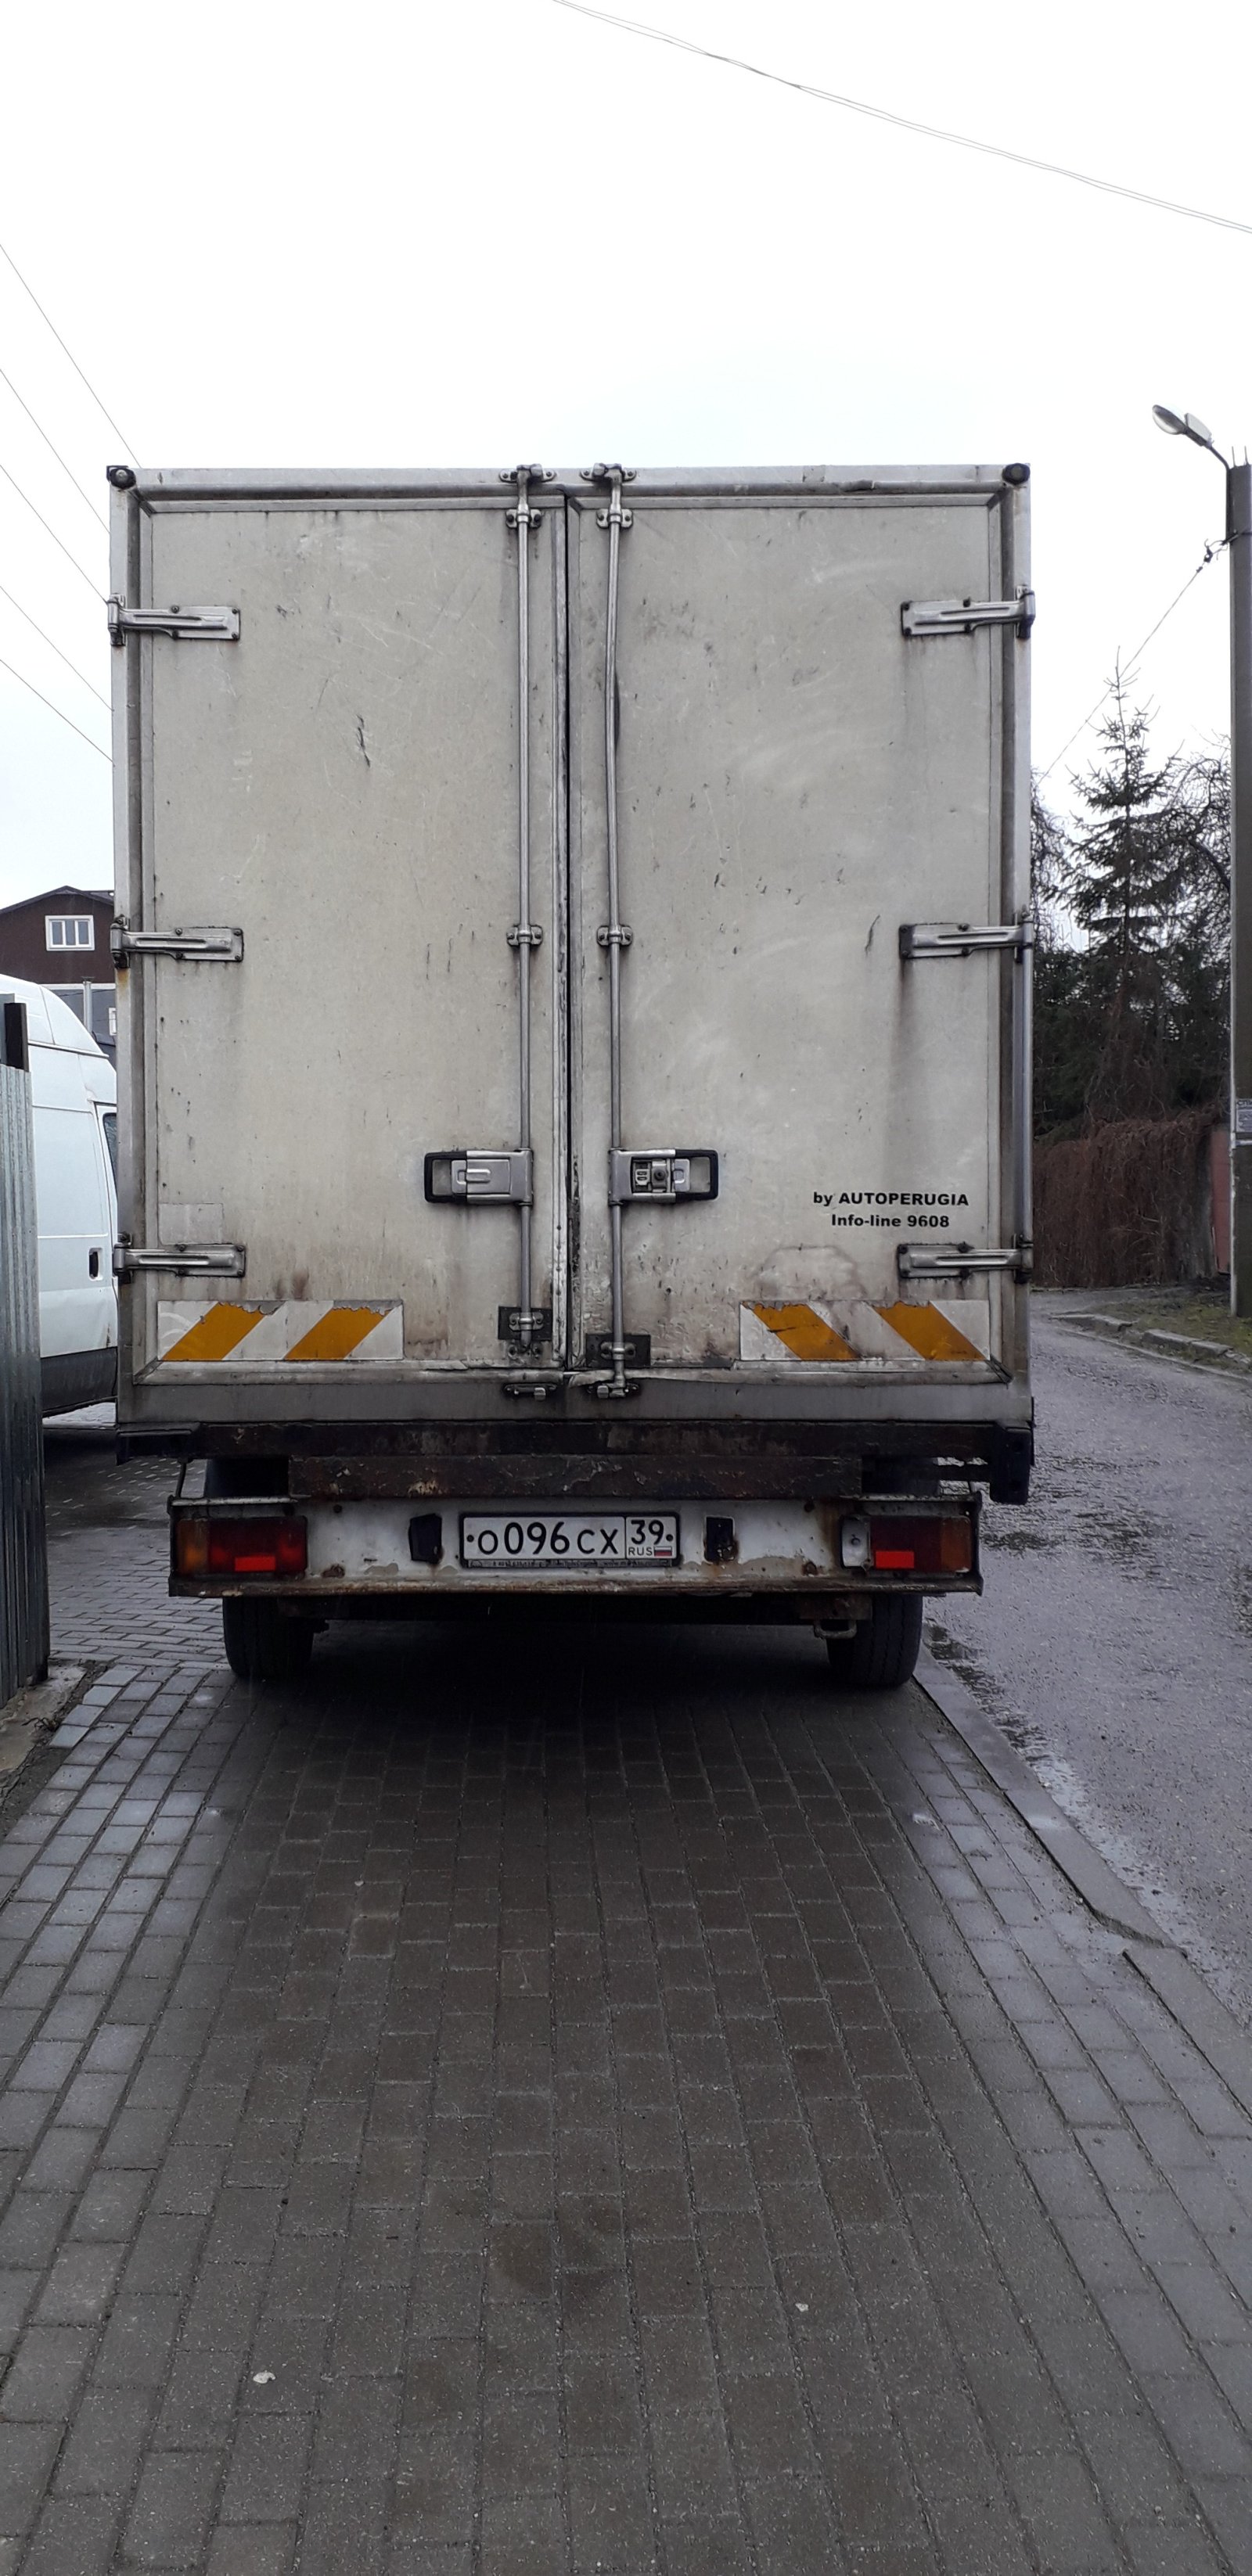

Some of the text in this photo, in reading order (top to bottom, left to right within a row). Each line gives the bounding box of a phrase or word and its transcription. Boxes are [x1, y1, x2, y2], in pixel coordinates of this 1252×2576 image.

[813, 1191, 969, 1207] by AUTOPERUGIA
[831, 1214, 950, 1228] Info-line 9608
[631, 1519, 664, 1545] 39
[628, 1547, 653, 1556] RUS
